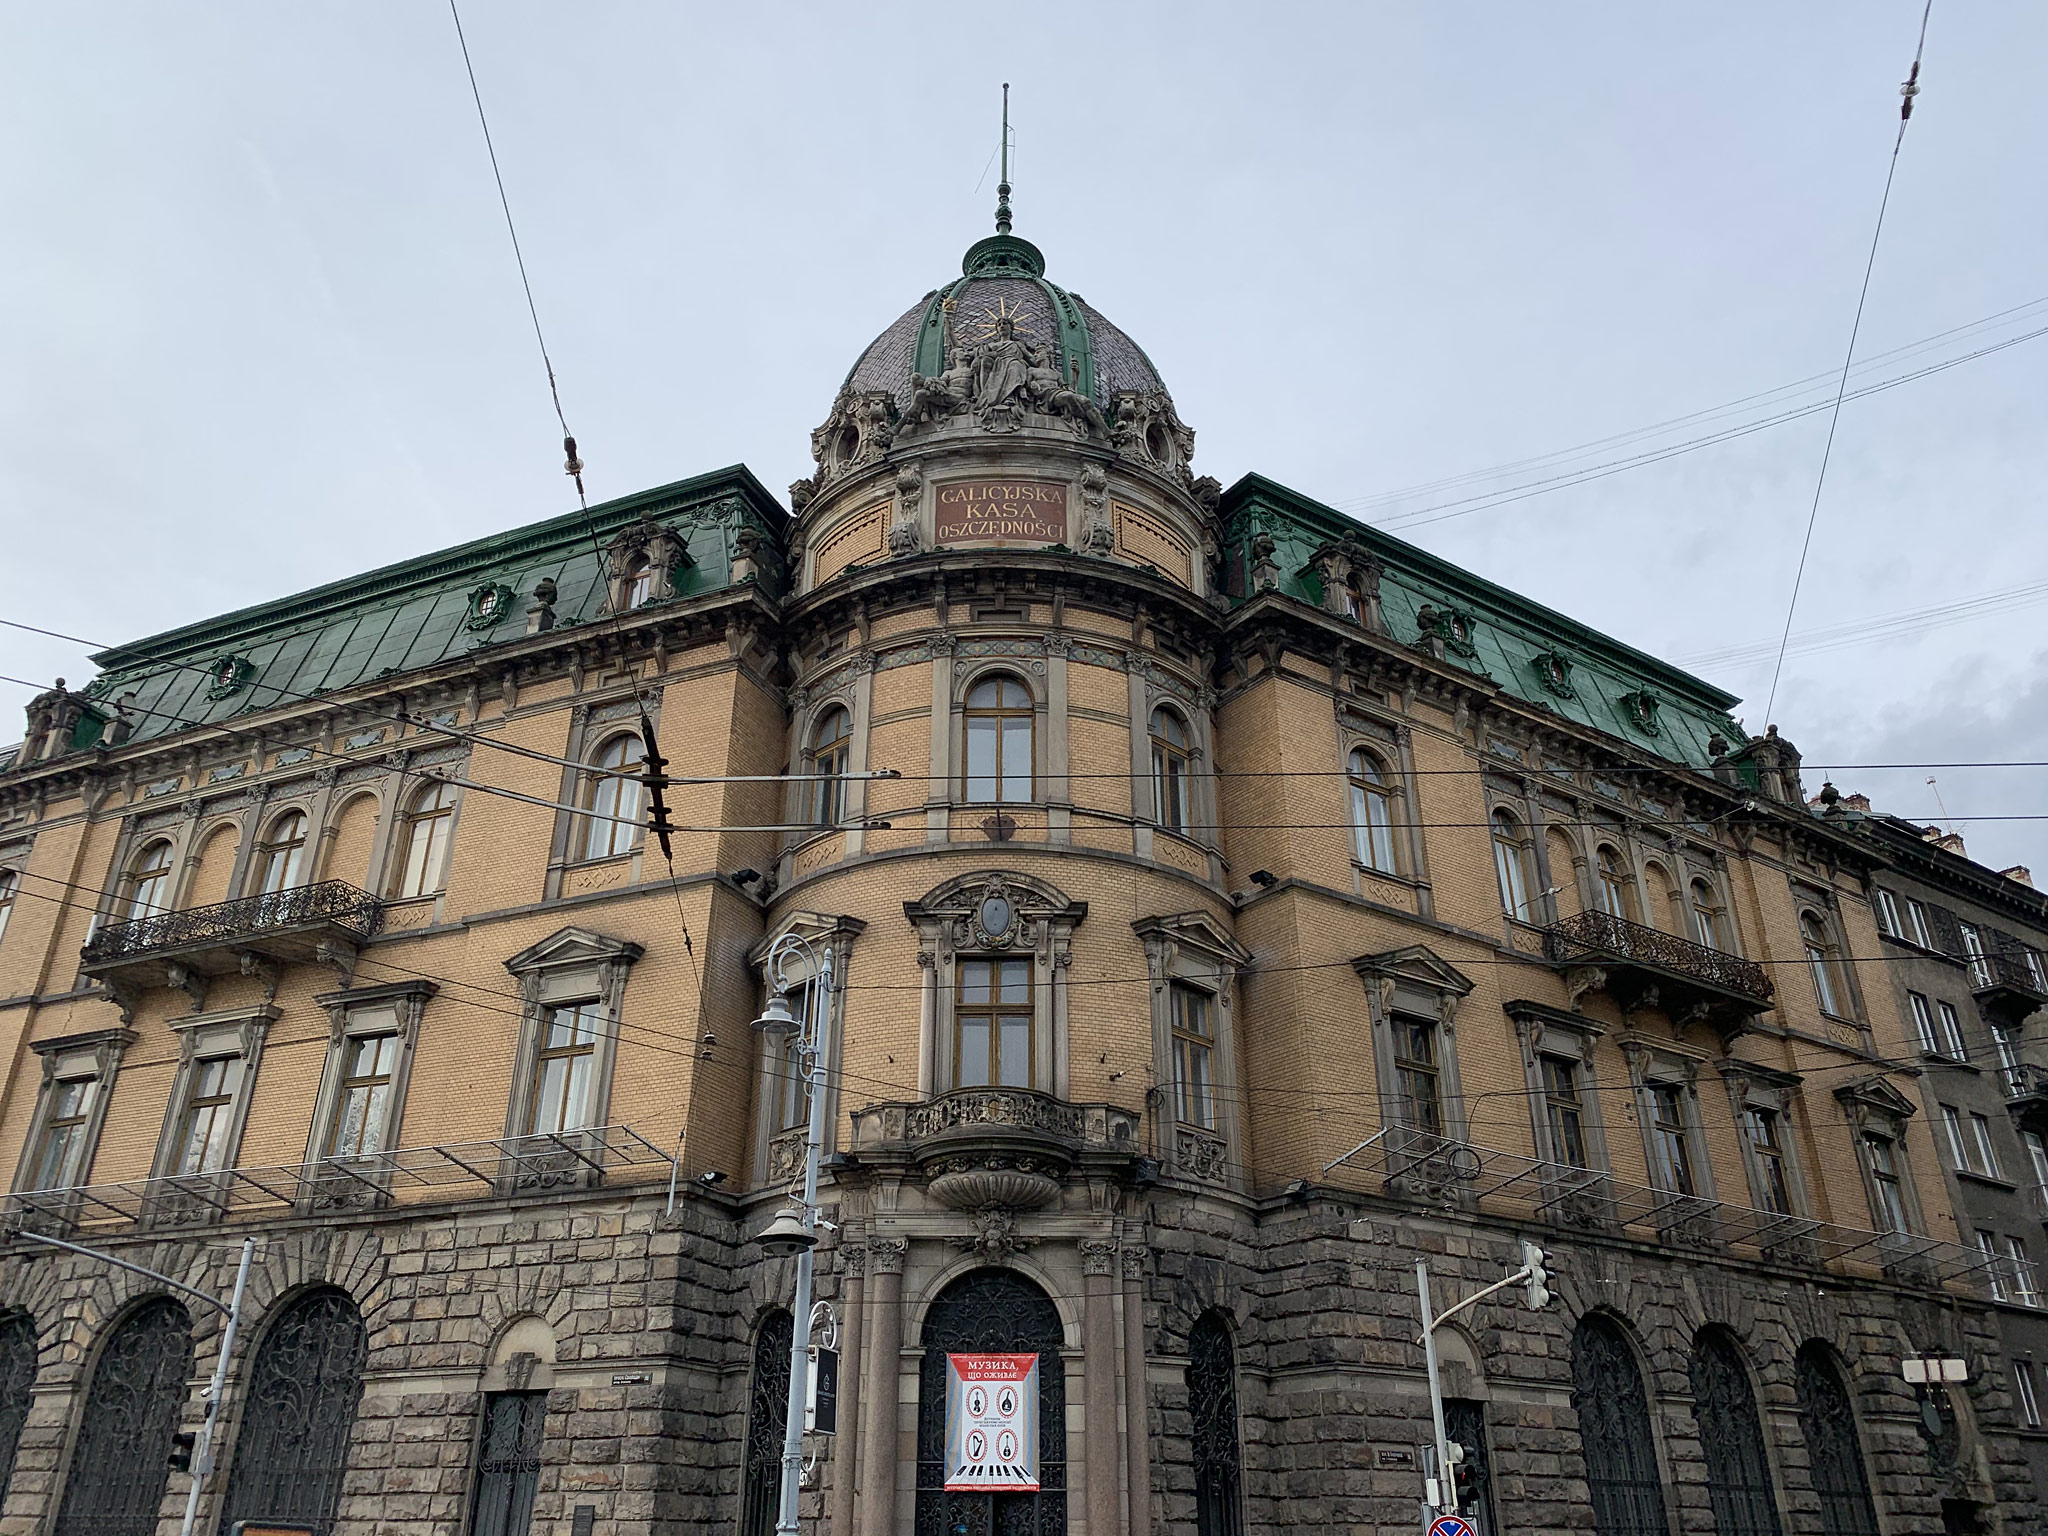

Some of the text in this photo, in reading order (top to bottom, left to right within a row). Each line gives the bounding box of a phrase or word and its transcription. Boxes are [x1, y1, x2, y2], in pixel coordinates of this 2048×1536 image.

[941, 486, 1063, 504] GALICYJSKA
[966, 502, 1037, 519] KASA
[967, 1361, 1019, 1371] МУЗИКА,
[967, 1372, 982, 1380] ЩО
